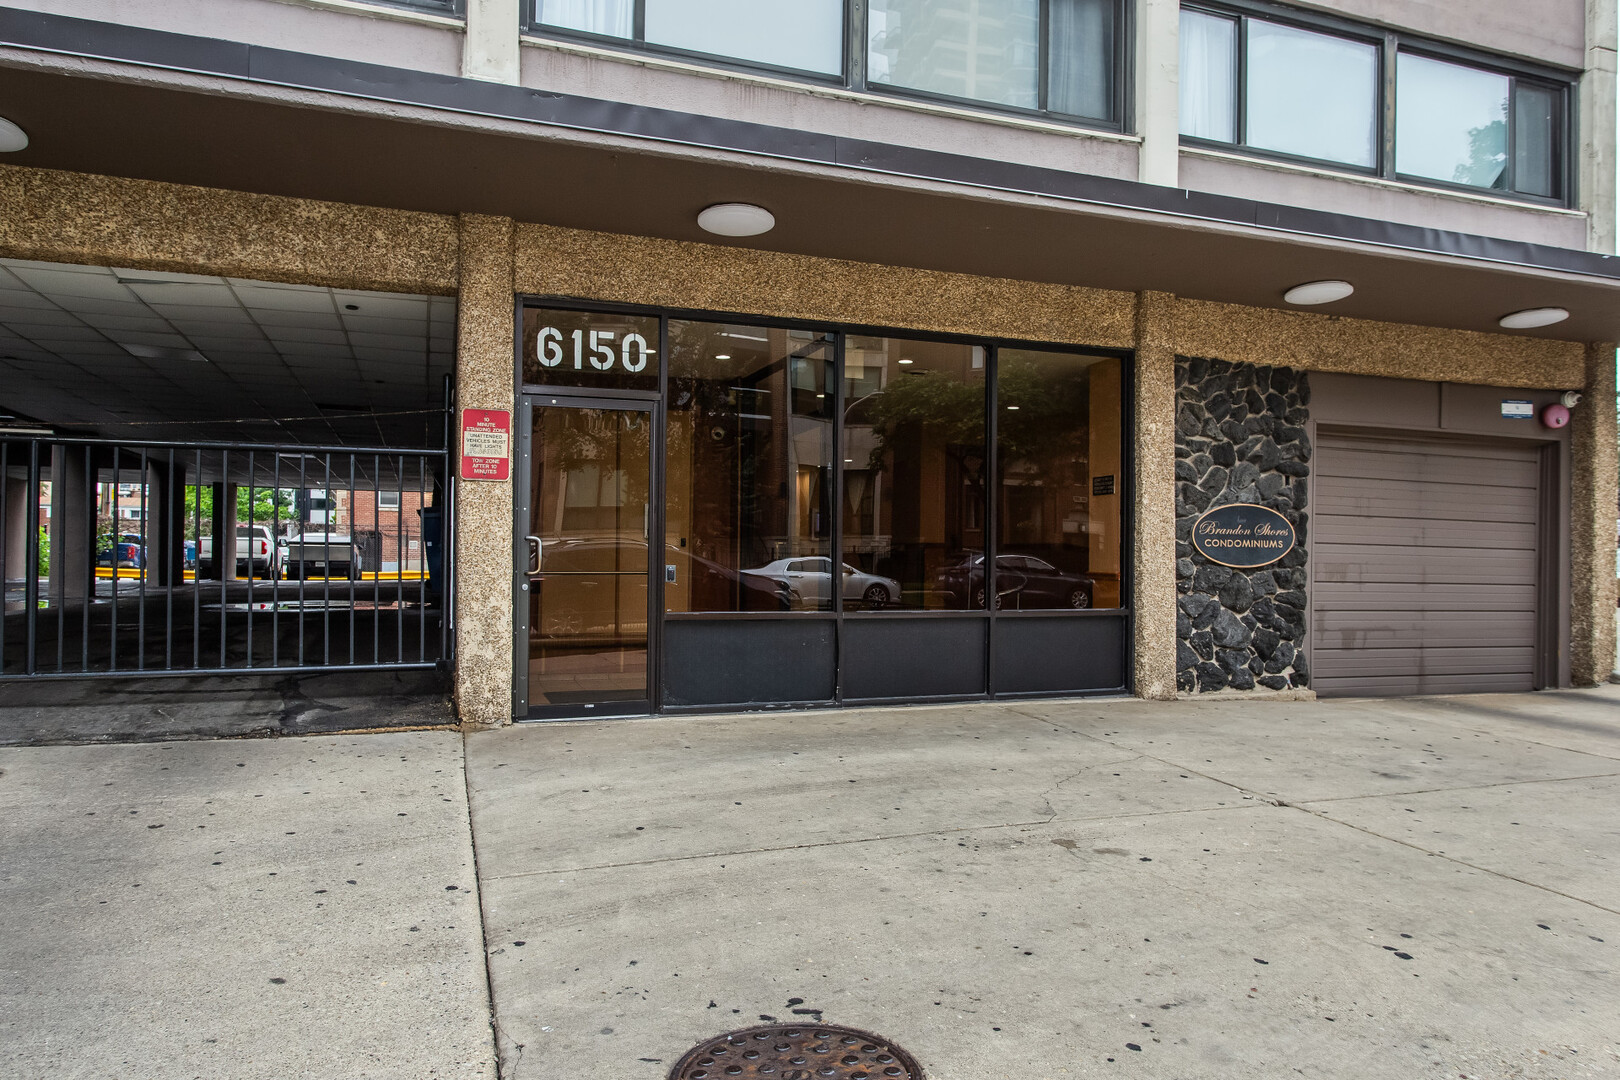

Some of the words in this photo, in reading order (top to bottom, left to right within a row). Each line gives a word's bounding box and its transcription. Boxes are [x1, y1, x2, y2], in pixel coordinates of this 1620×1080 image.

[537, 326, 647, 373] 6150
[1199, 520, 1251, 535] Brandon
[1254, 522, 1289, 537] Shores
[1204, 538, 1284, 548] CONDOMINIUMS
